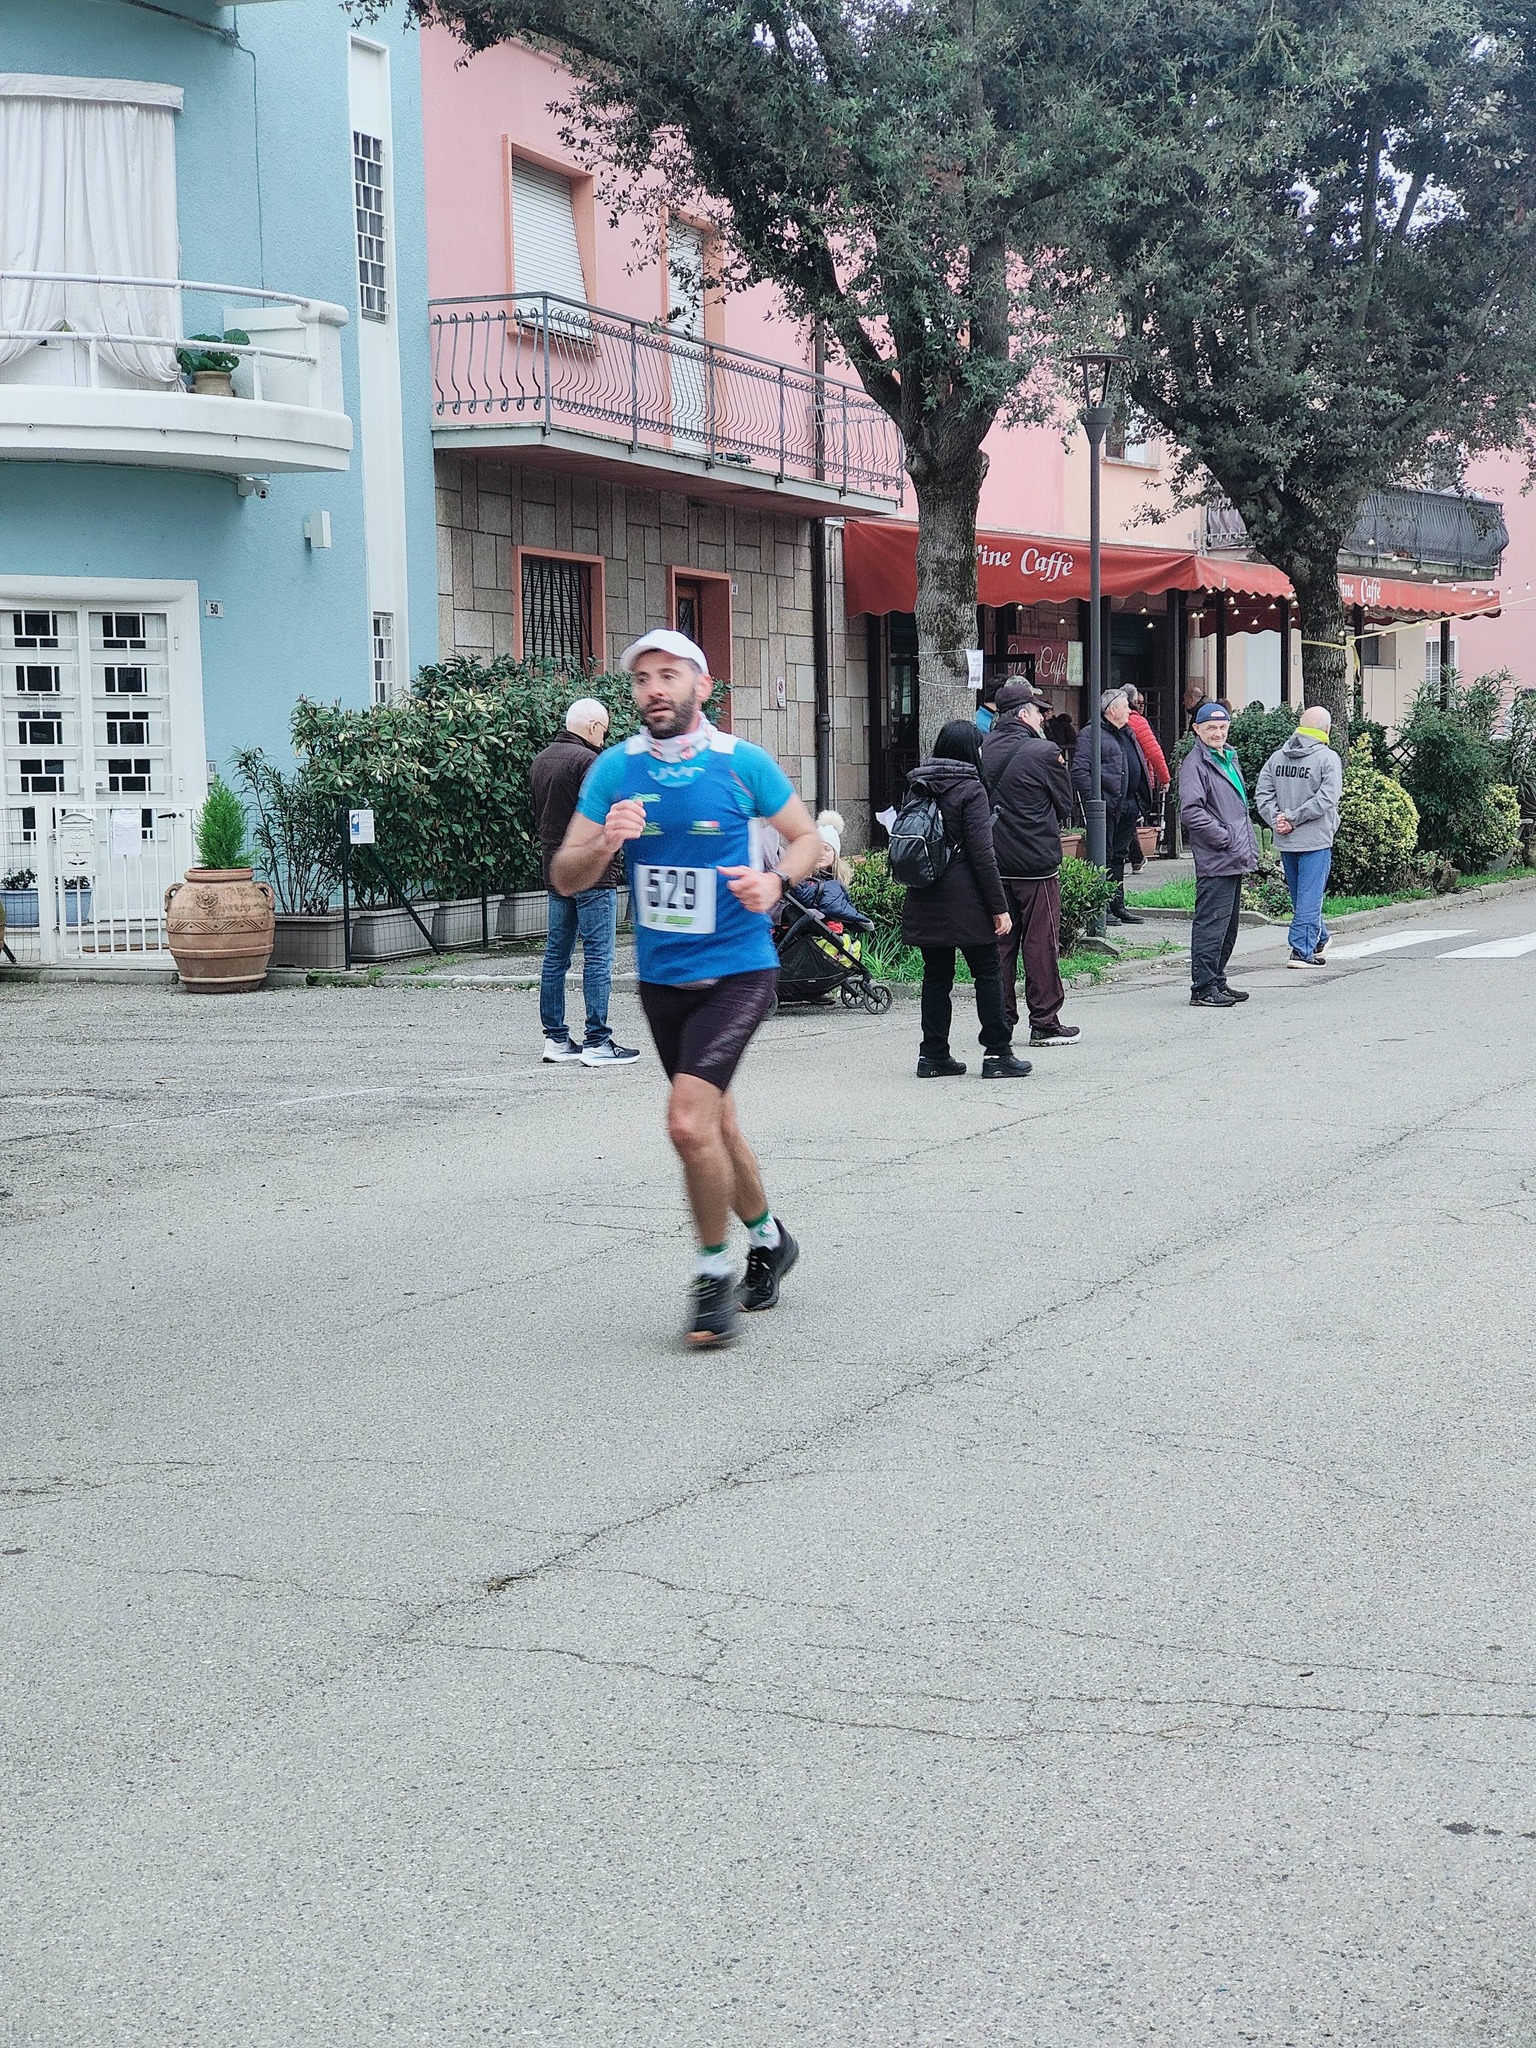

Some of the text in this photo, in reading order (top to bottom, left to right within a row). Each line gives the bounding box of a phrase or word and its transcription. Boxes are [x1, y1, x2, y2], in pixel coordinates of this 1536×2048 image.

[1020, 547, 1074, 582] Caffè
[210, 603, 219, 614] 50
[1275, 765, 1311, 779] GIUDICE
[648, 868, 696, 910] 529
